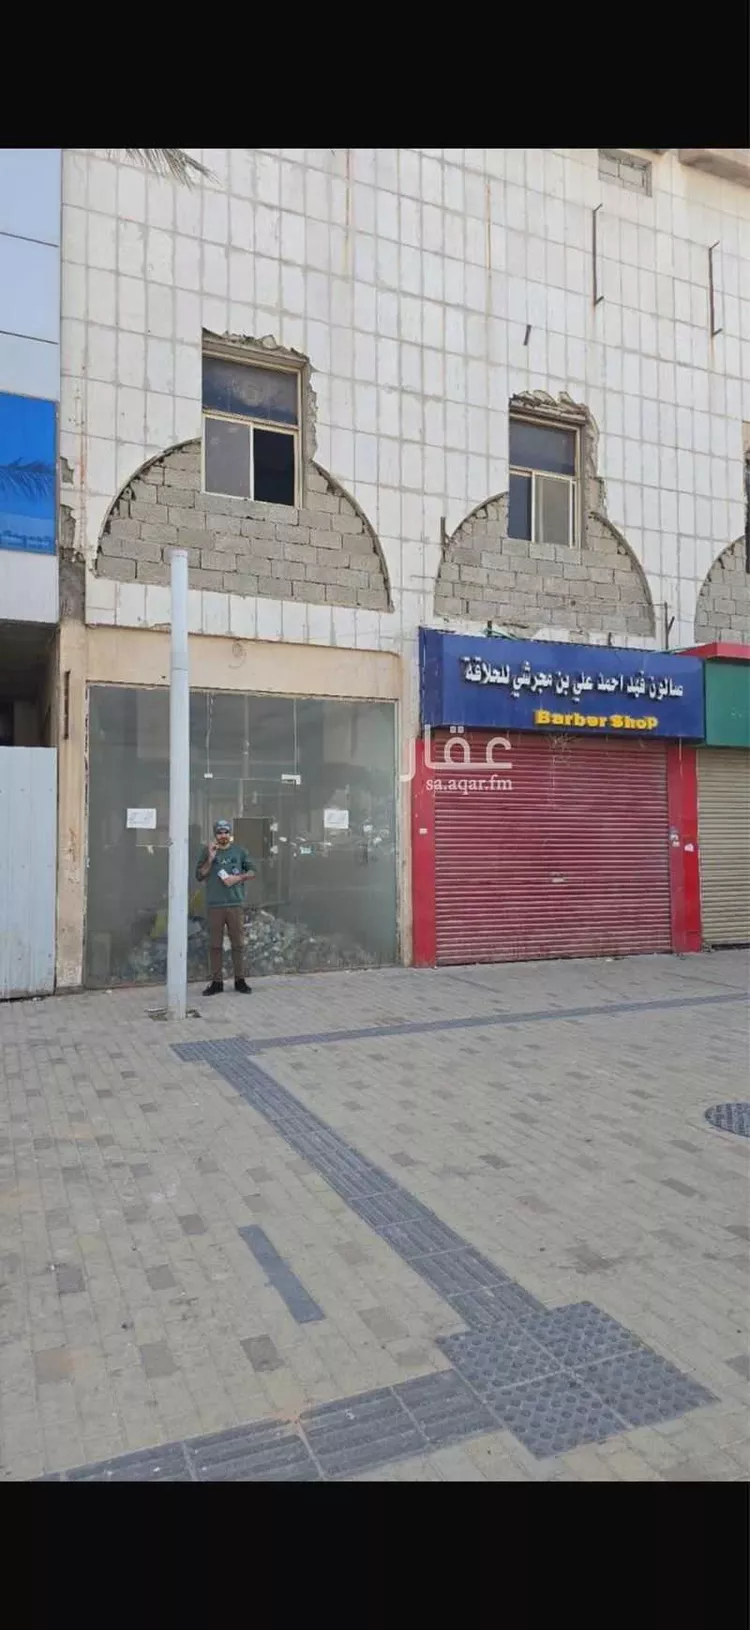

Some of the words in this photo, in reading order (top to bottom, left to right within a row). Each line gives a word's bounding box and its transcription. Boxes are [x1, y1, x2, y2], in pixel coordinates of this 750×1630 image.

[462, 656, 510, 684] للحلاقة
[556, 671, 570, 695] بن
[627, 670, 646, 698] فهد
[572, 672, 593, 702] علي
[535, 709, 607, 728] Barber
